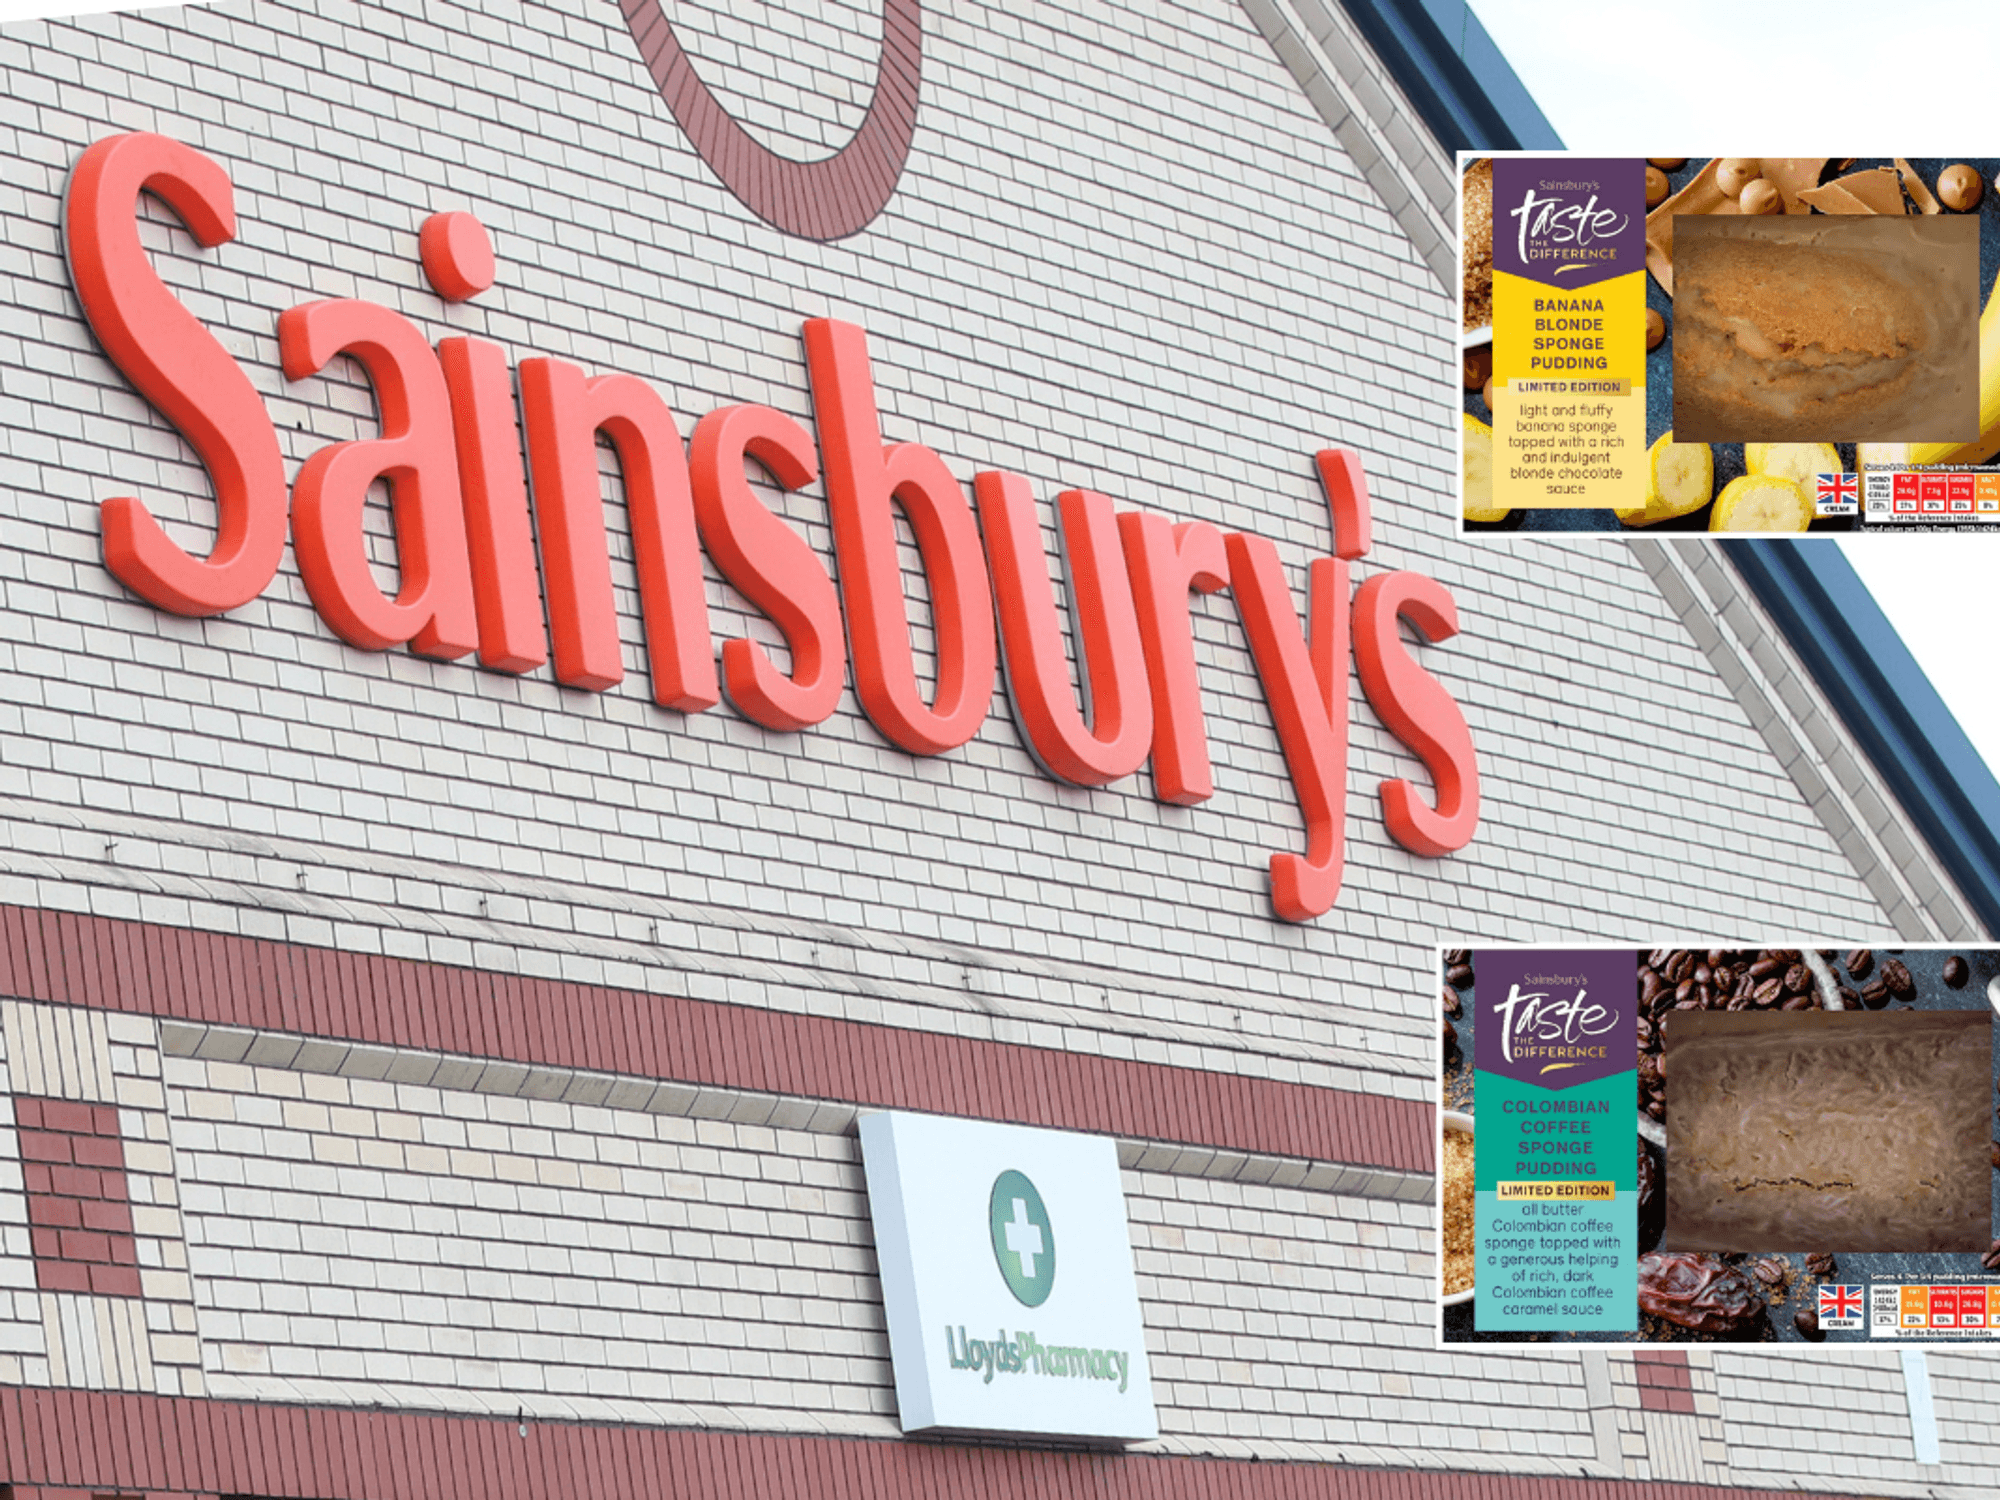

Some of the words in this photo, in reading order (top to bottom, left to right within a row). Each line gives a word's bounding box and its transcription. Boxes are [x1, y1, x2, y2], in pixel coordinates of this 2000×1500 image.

[1539, 180, 1600, 192] Sainsbury's
[1510, 189, 1629, 264] taste
[1529, 239, 1548, 247] THE
[1529, 248, 1617, 260] DIFFERENCE
[1534, 298, 1604, 312] BANANA
[1535, 318, 1604, 331] BLONDE
[1533, 337, 1605, 351] SPONGE
[1531, 356, 1608, 370] PUDDING
[1518, 382, 1567, 392] LIMITED
[1570, 382, 1621, 392] EDITION
[1519, 404, 1548, 419] light
[1552, 404, 1576, 417] and
[1580, 404, 1613, 419] fluffy
[1516, 420, 1565, 432] banana
[1569, 421, 1617, 435] sponge
[1508, 436, 1555, 450] topped
[1558, 436, 1585, 448] with
[1588, 438, 1597, 448] a
[1600, 436, 1625, 448] rich
[1522, 452, 1547, 464] and
[1550, 451, 1611, 466] indulgent
[1510, 467, 1555, 479] blonde
[1557, 467, 1623, 479] chocolate
[1546, 484, 1586, 494] sauce
[64, 130, 1481, 923] Sainsbury's
[1524, 973, 1588, 987] Sainsbury's
[1493, 984, 1619, 1063] taste
[1513, 1036, 1534, 1045] THE
[1513, 1046, 1607, 1058] DIFFERENCE
[1502, 1100, 1610, 1114] COLOMBIAN
[1520, 1120, 1591, 1134] COFFEE
[1518, 1141, 1593, 1155] SPONGE
[1515, 1161, 1597, 1175] PUDDING
[1501, 1185, 1553, 1196] LIMITED
[1557, 1185, 1610, 1196] EDITION
[1521, 1203, 1539, 1216] all
[1541, 1203, 1585, 1216] butter
[1492, 1218, 1566, 1232] Colombian
[1570, 1218, 1614, 1232] coffee
[1484, 1238, 1535, 1251] sponge
[1540, 1236, 1589, 1251] topped
[1593, 1236, 1622, 1249] with
[1487, 1255, 1497, 1266] a
[1500, 1255, 1565, 1268] generous
[1568, 1253, 1619, 1268] helping
[1511, 1269, 1526, 1282] of
[1529, 1269, 1559, 1283] rich,
[1563, 1269, 1595, 1282] dark
[1492, 1286, 1566, 1299] Colombian
[1570, 1286, 1614, 1299] coffee
[1502, 1303, 1558, 1315] caramel
[1561, 1304, 1604, 1315] sauce
[945, 1325, 1129, 1394] LloydsPharmacy
